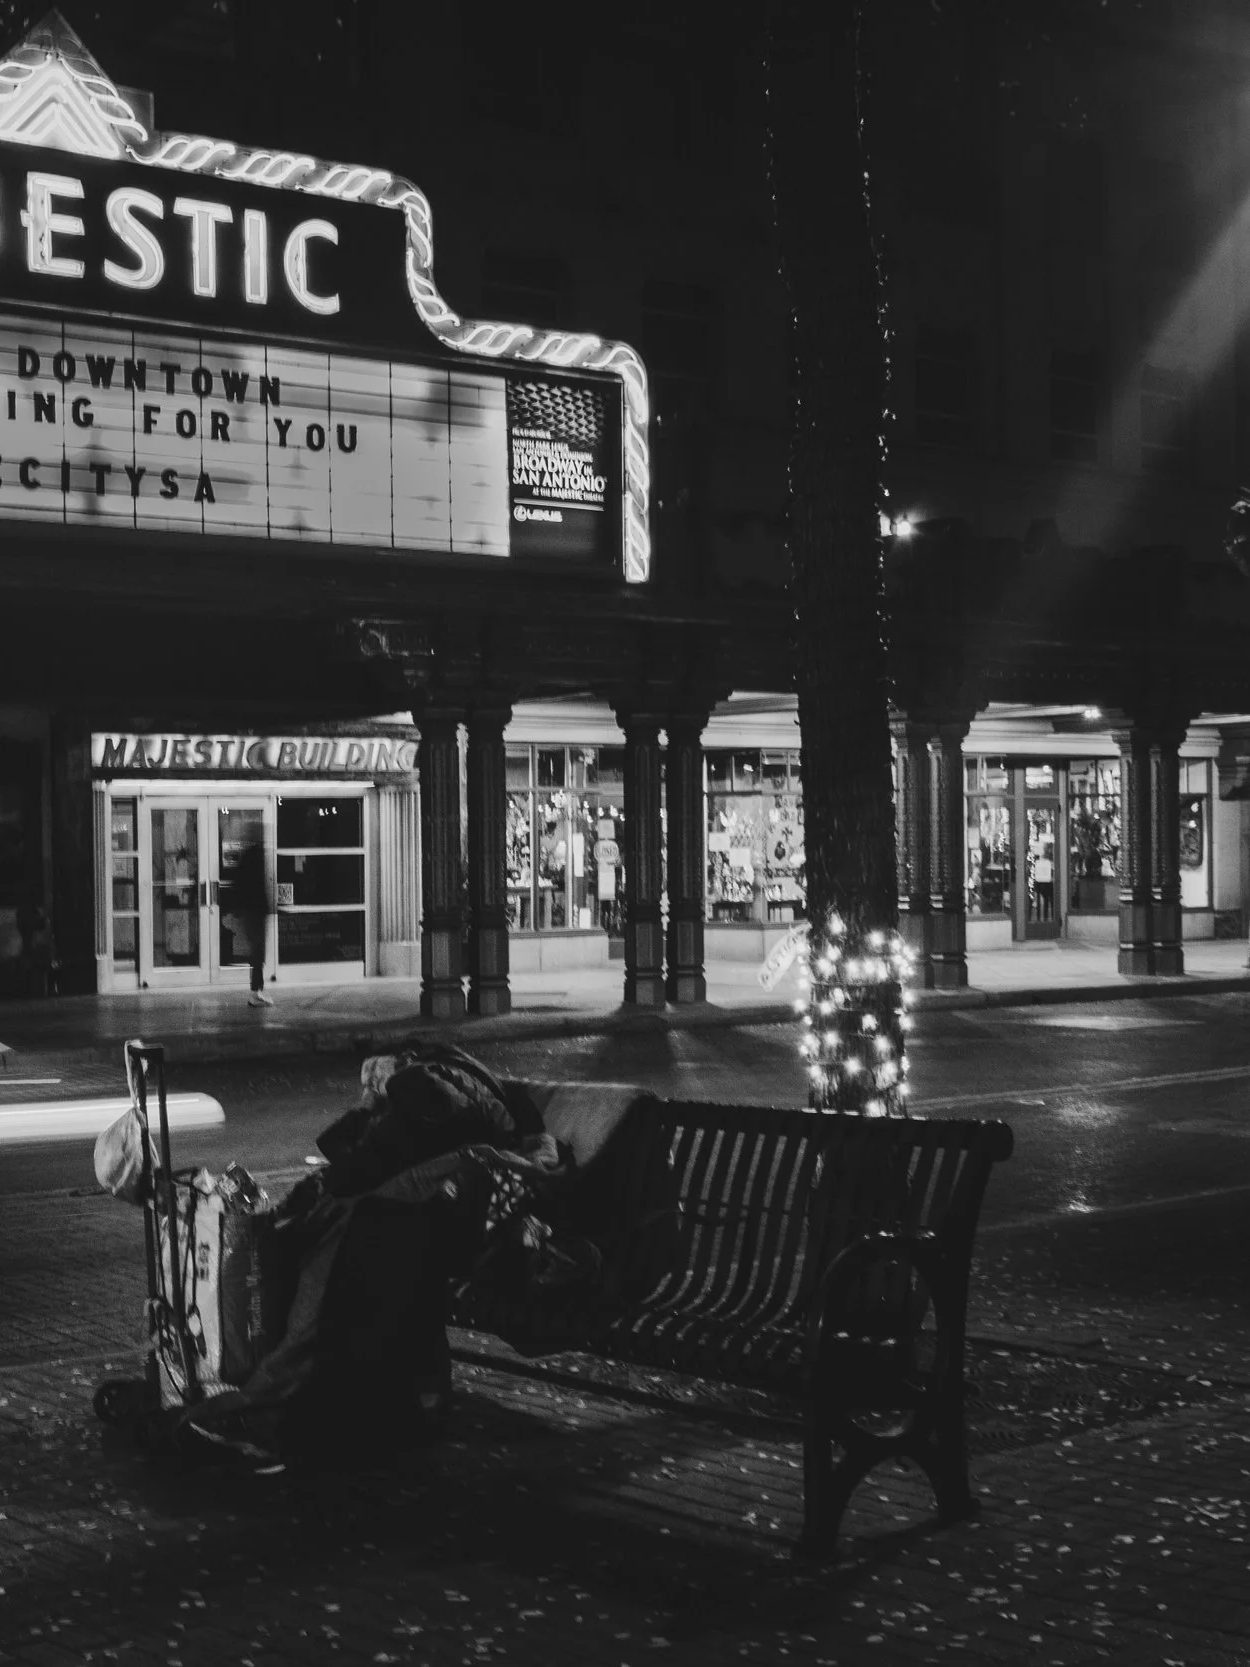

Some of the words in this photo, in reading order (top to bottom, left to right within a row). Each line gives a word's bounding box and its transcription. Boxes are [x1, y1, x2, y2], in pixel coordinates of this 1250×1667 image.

[18, 345, 281, 406] DOWNTOWN
[142, 404, 231, 442] FOR
[273, 417, 359, 455] YOU
[513, 452, 584, 476] BROADWAY
[513, 470, 540, 486] SAN
[102, 738, 267, 769] MAJESTIC
[278, 741, 416, 772] BUILDING
